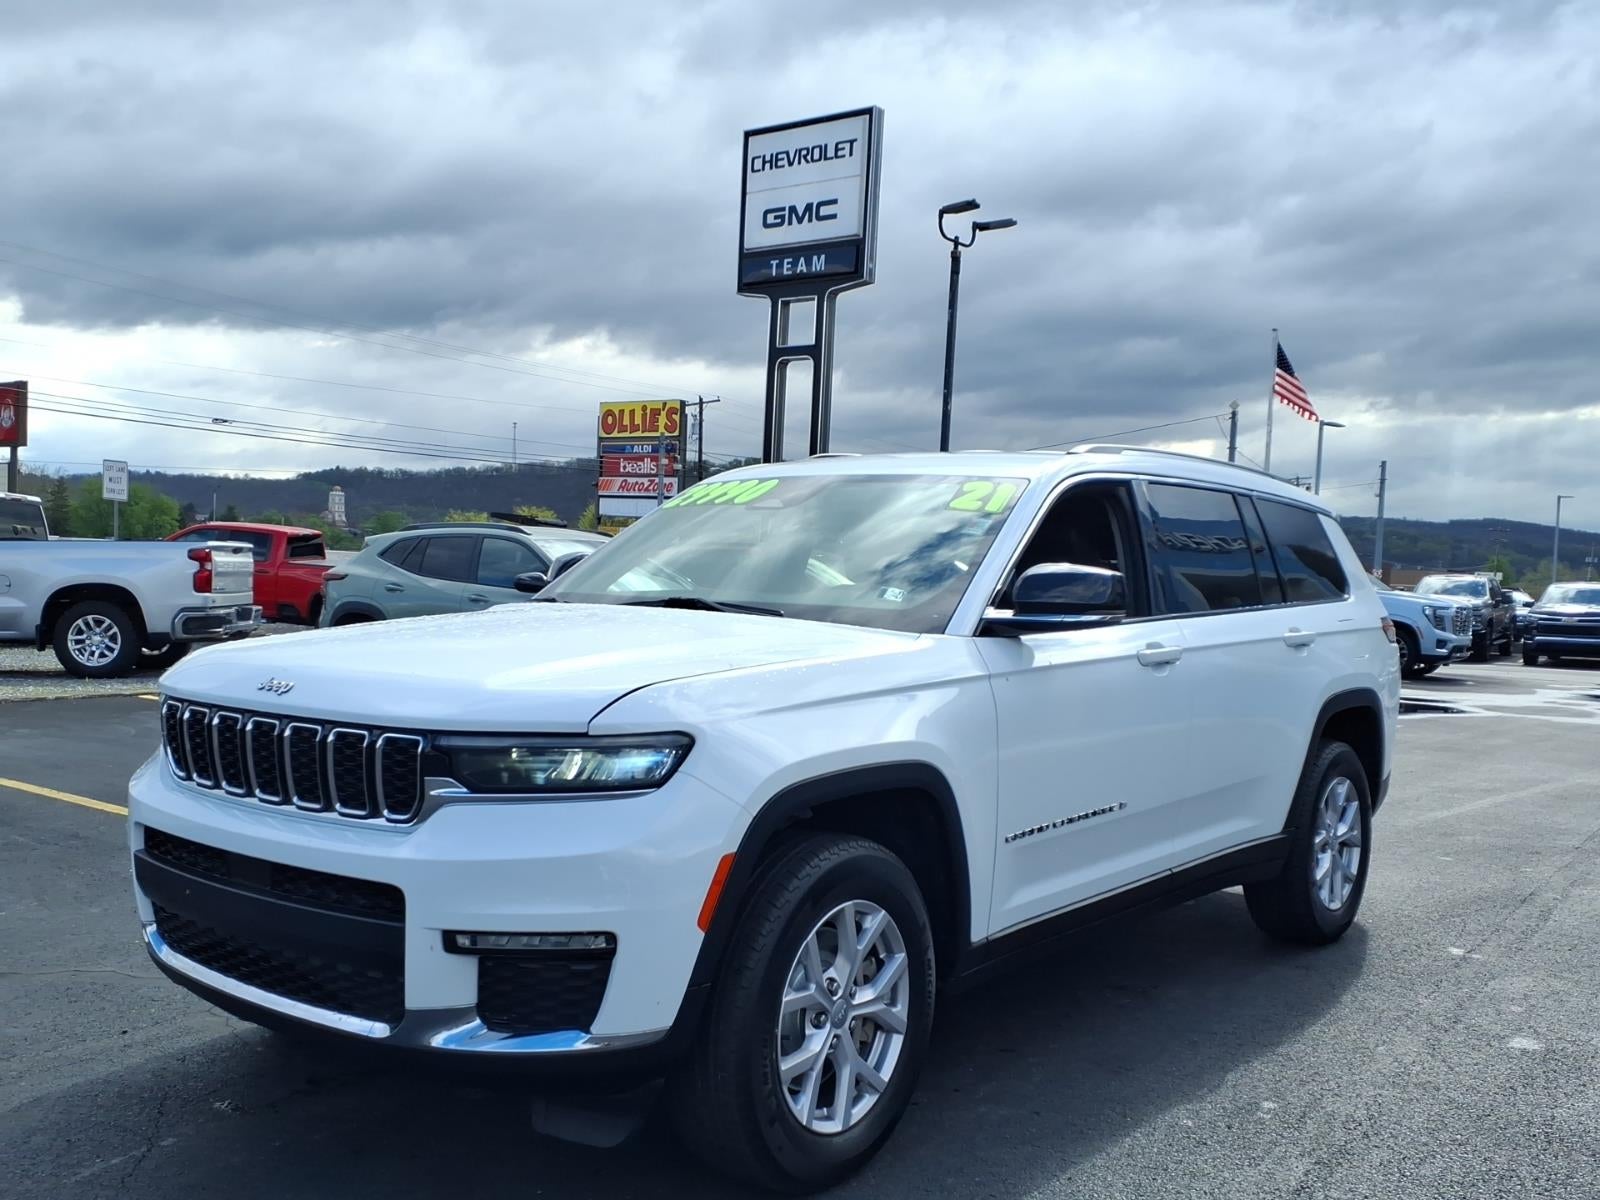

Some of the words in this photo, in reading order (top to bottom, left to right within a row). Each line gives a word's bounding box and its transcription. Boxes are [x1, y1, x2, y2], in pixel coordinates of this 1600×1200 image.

[750, 138, 858, 174] CHEVROLET
[762, 198, 839, 229] GMC
[770, 254, 826, 277] TEAM
[633, 445, 653, 454] ALDI
[620, 457, 658, 474] bealls
[108, 476, 122, 485] MUST
[948, 480, 1018, 513] 21
[256, 676, 296, 697] Jeep
